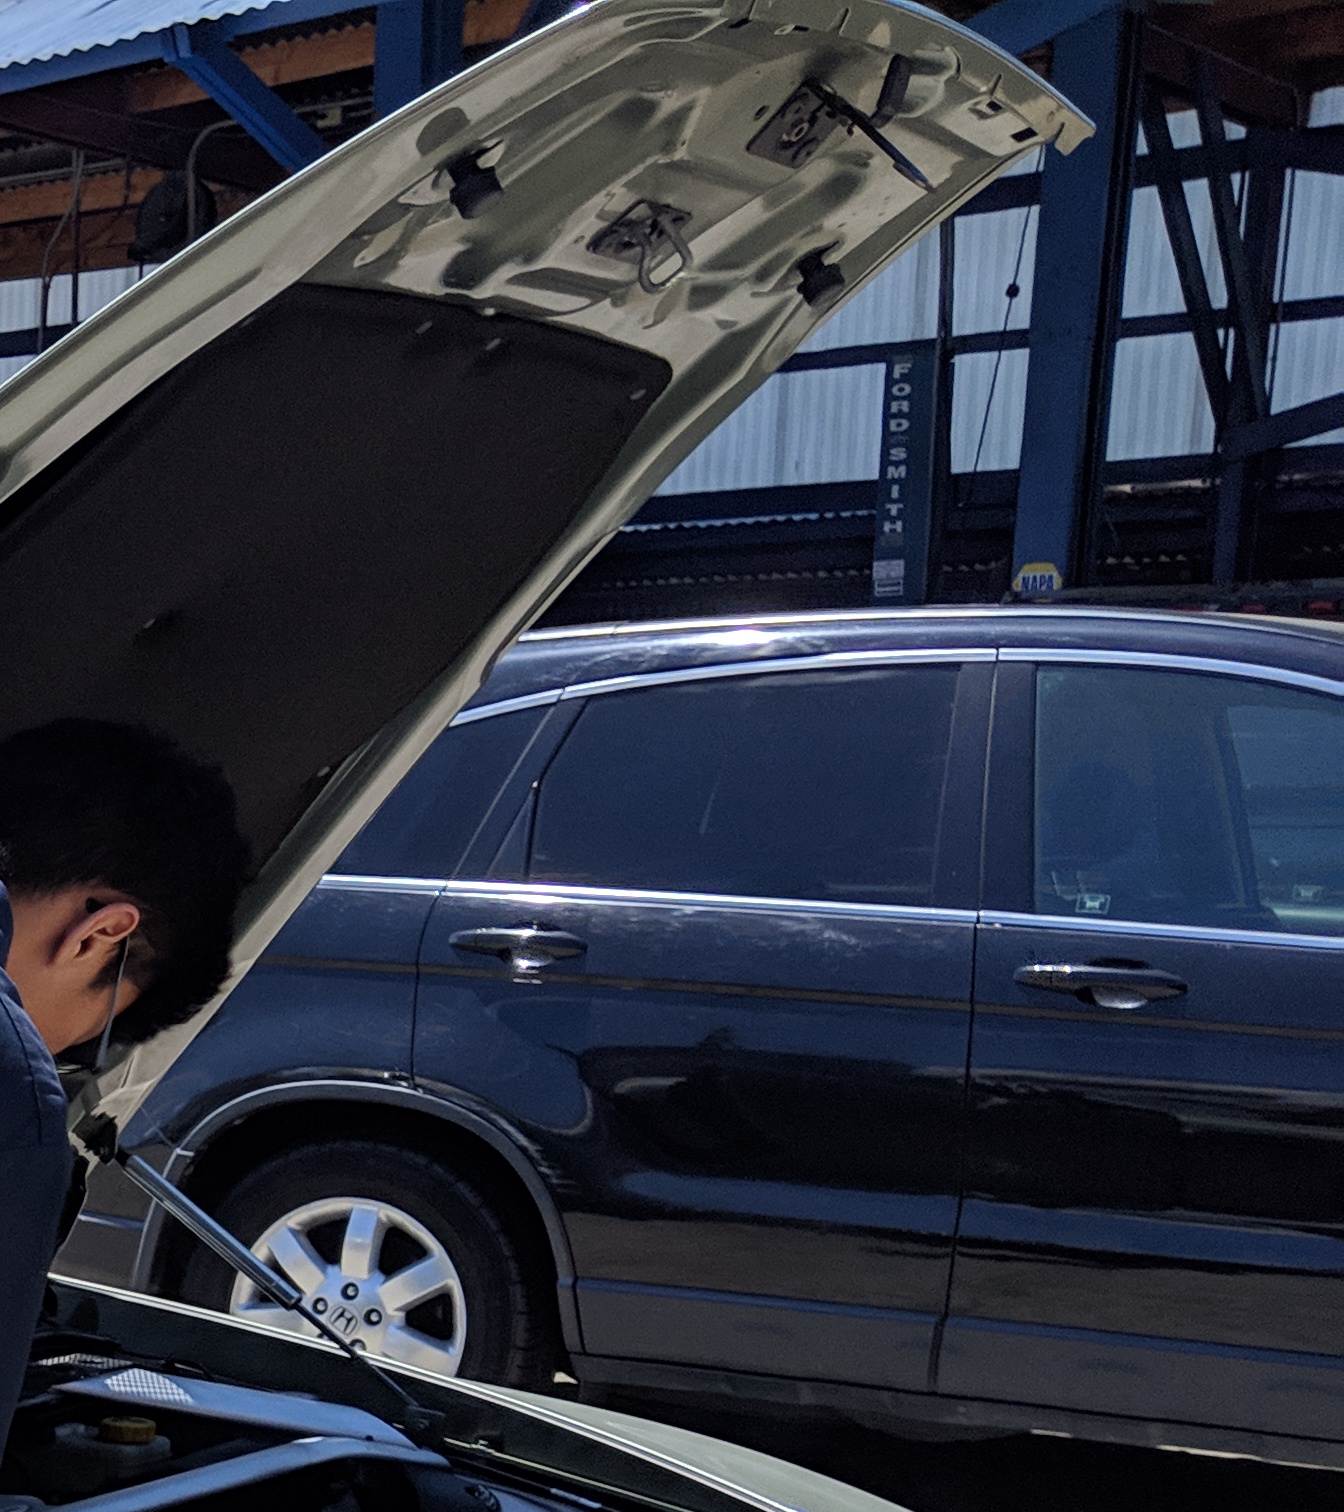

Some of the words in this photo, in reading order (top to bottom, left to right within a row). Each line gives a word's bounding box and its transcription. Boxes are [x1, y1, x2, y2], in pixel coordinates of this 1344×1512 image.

[889, 363, 912, 432] FORD
[883, 447, 907, 533] SMITH
[1021, 574, 1054, 591] NAPA
